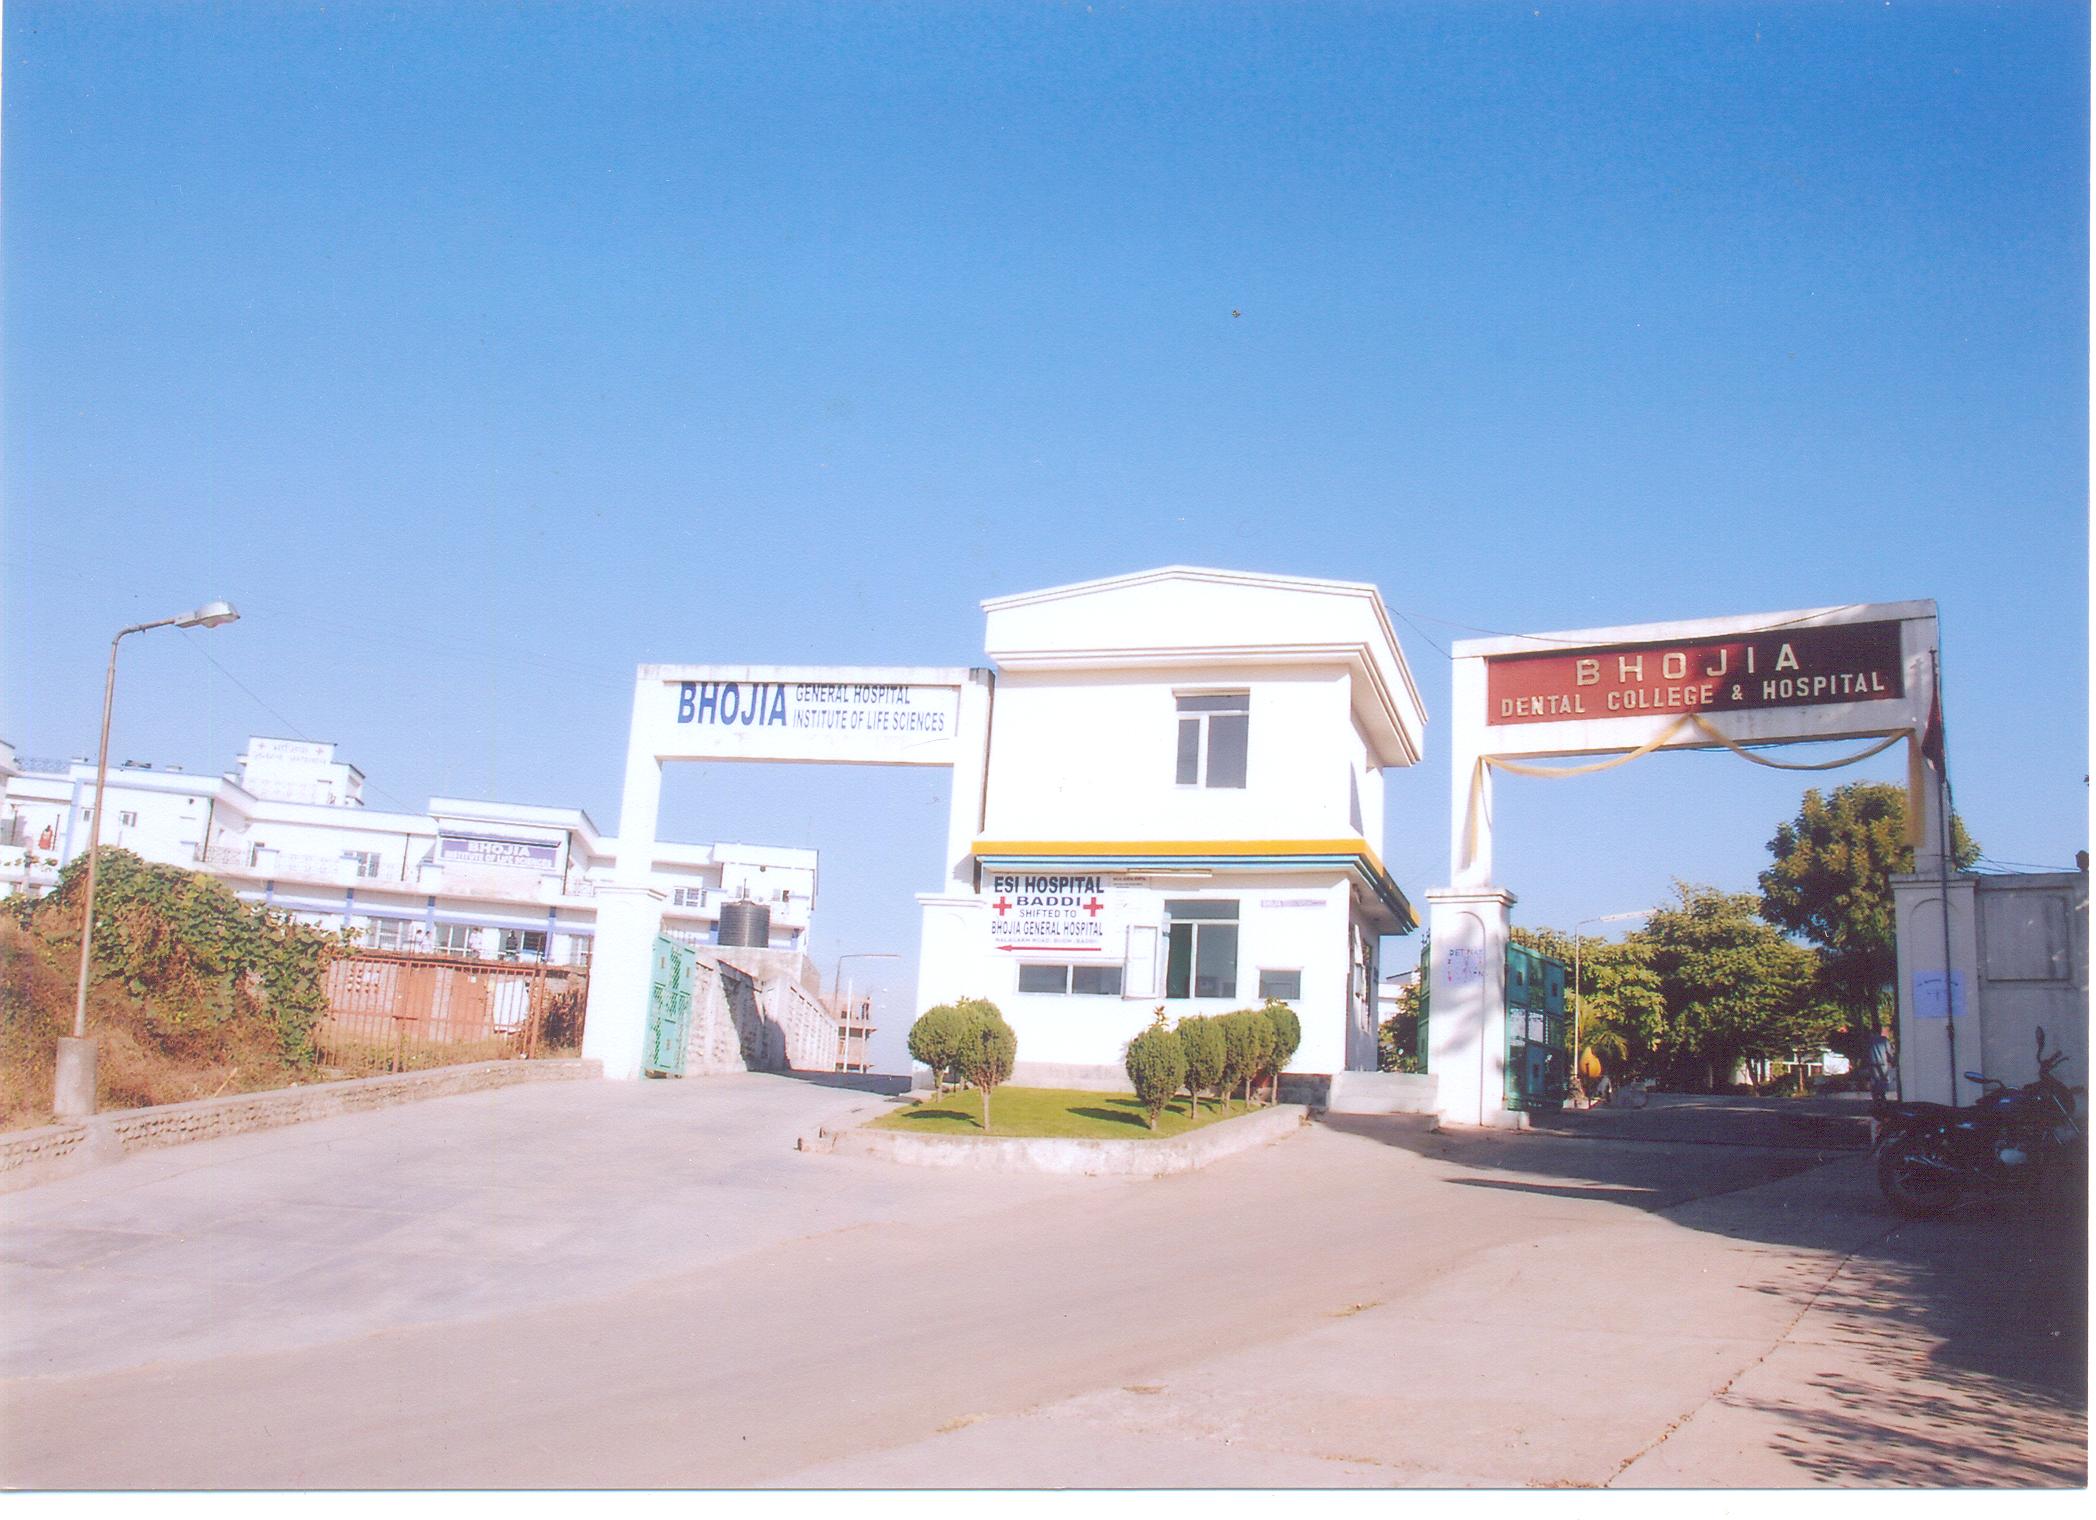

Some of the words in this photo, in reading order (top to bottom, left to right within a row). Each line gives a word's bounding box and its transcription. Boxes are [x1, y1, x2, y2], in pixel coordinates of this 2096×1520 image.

[1576, 643, 1799, 686] BHOJIA
[795, 684, 849, 703] GENERAL
[853, 685, 910, 704] HOSPITAL
[1501, 694, 1585, 717] DENTAL
[1608, 684, 1713, 711] COLLEGE
[1731, 684, 1743, 701] &
[1763, 671, 1885, 700] HOSPITAL
[677, 682, 787, 725] BHOJIA
[793, 710, 848, 729] INSTITUTE
[851, 711, 865, 729] OF
[867, 711, 889, 730] LIFE
[893, 712, 945, 732] SCIENCES
[467, 841, 531, 857] BHOJIA
[995, 876, 1019, 893] ESI
[1025, 876, 1104, 893] HOSPITAL
[1016, 896, 1081, 907] BADDI
[1019, 909, 1061, 918] SHIFTED
[1065, 909, 1077, 918] TO
[992, 921, 1020, 935] BHOJIA
[1023, 921, 1061, 935] GENERAL
[1063, 921, 1103, 936] HOSPITAL
